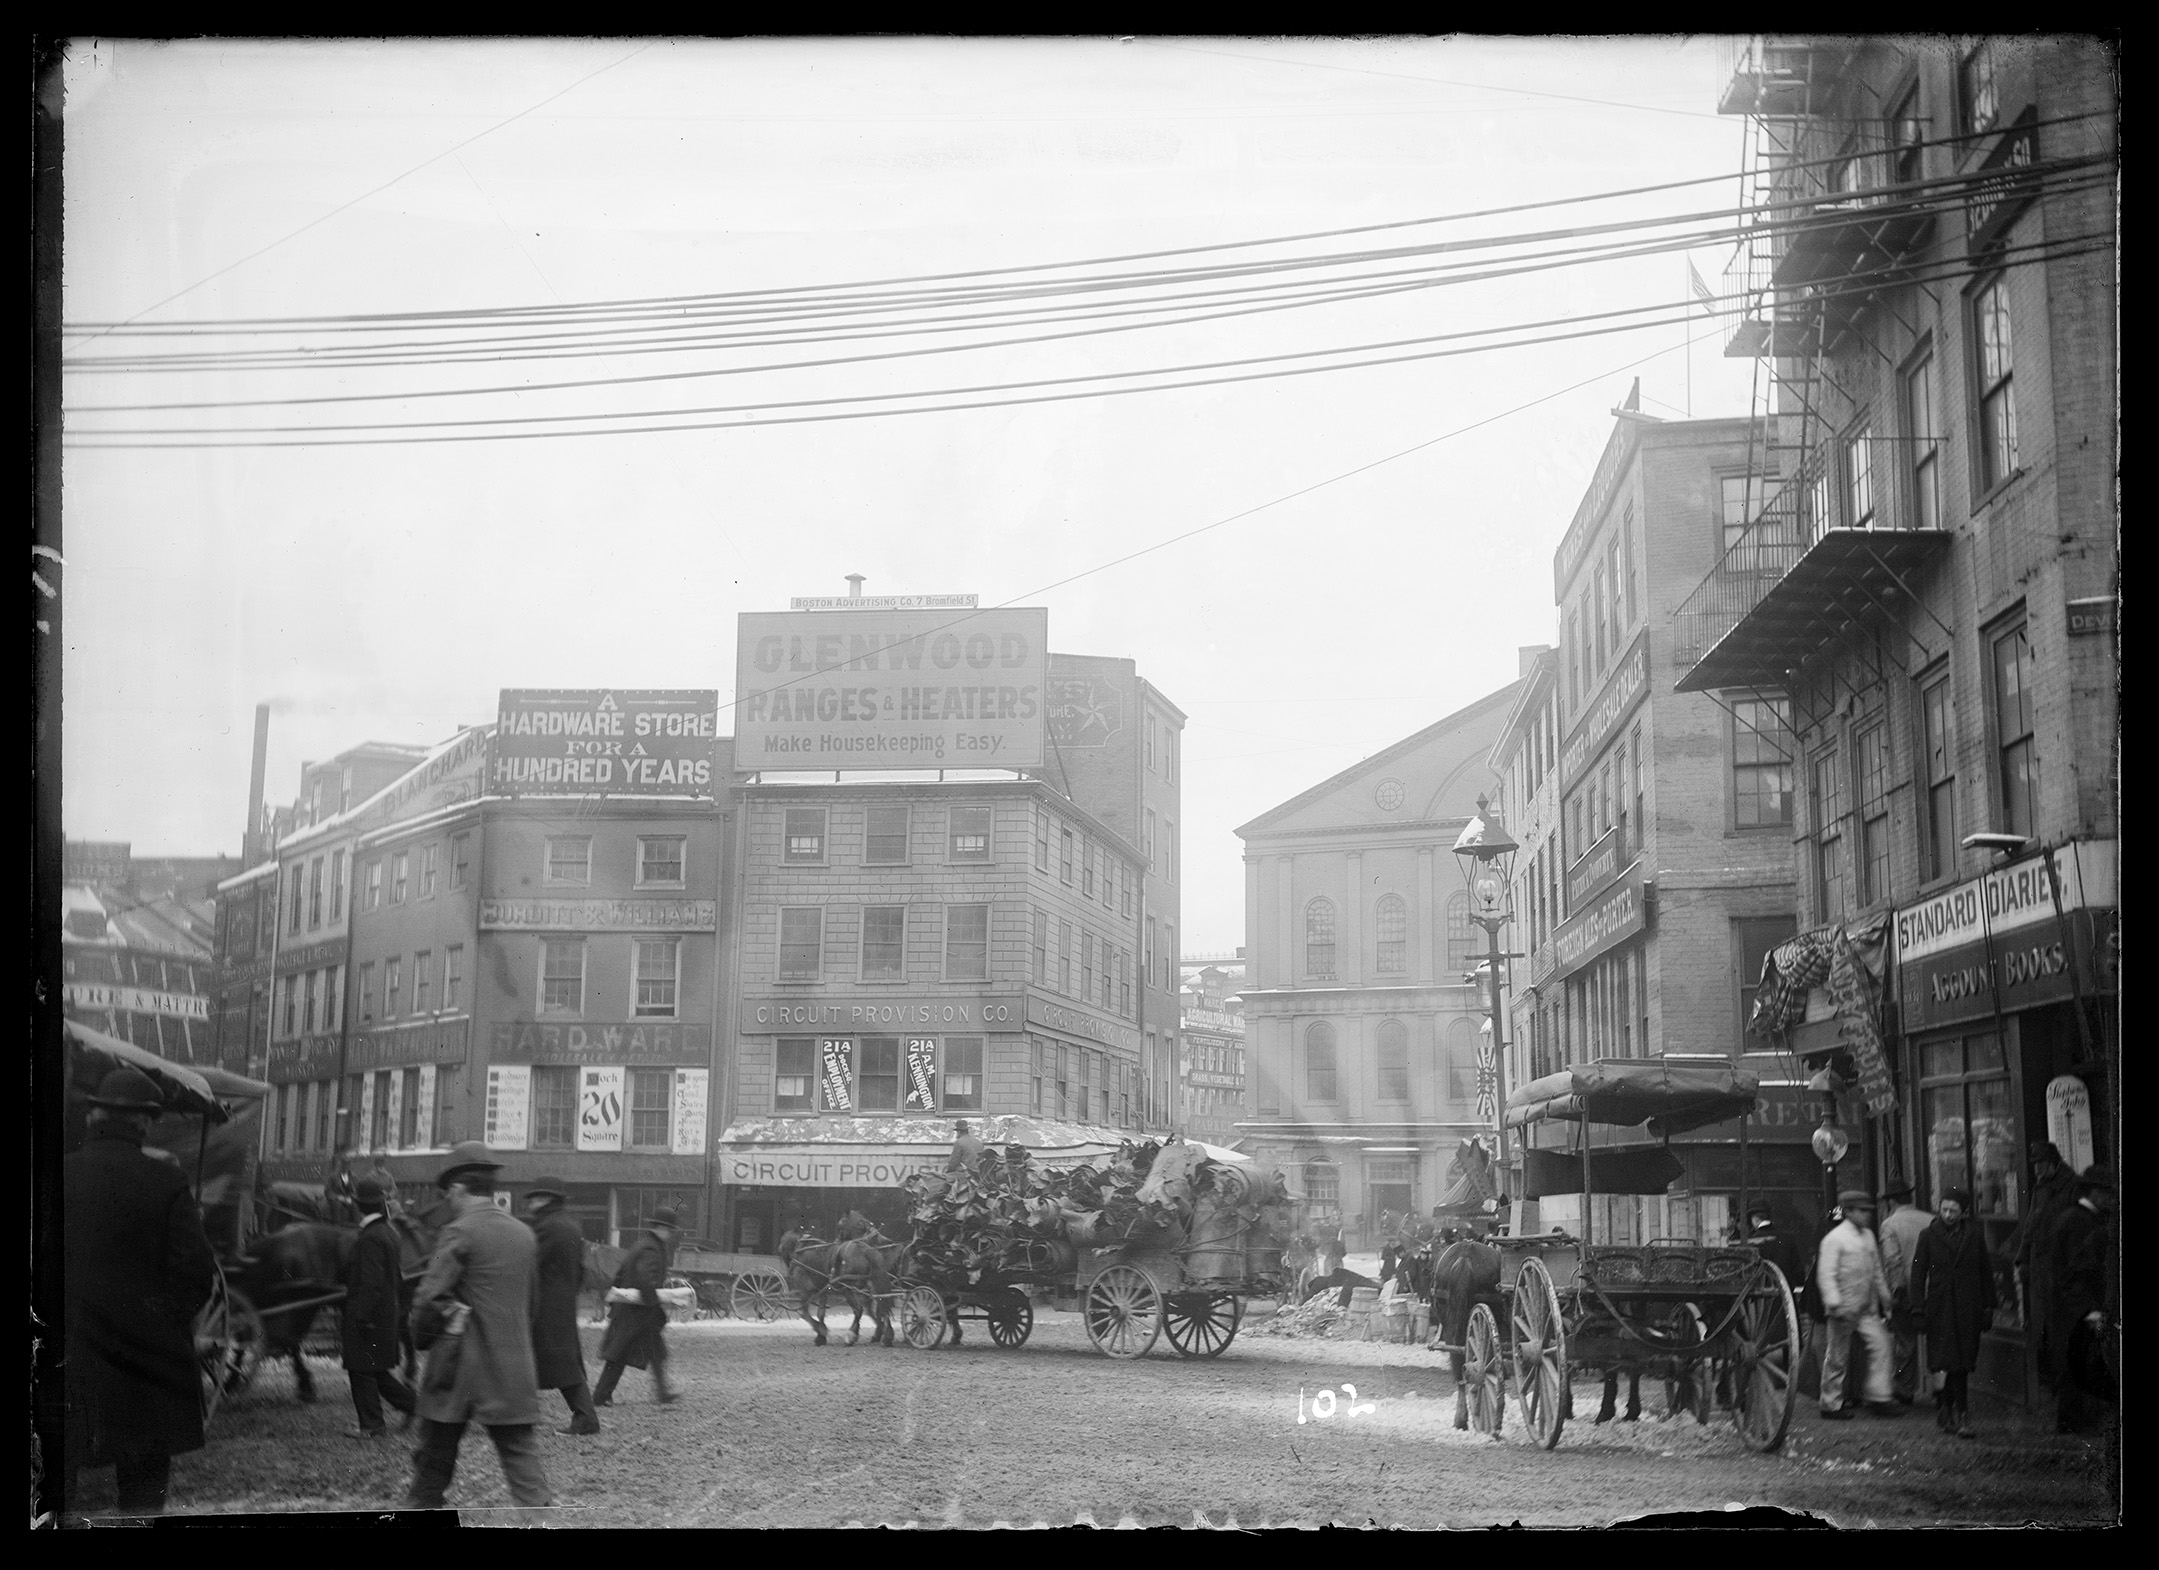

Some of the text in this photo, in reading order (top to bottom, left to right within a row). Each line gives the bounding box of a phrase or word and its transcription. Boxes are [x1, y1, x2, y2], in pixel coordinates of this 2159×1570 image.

[795, 598, 832, 607] BOSTON
[836, 597, 896, 607] ADVERTISING
[916, 597, 922, 605] 7
[925, 595, 964, 605] Bromfield
[755, 632, 1029, 673] GLENWOOD
[597, 692, 618, 711] A
[747, 687, 878, 723] RANGES
[883, 694, 895, 712] &
[900, 685, 1038, 722] HEATERS
[501, 711, 714, 737] HARDWARE STORE
[566, 740, 648, 756] FOR A
[764, 732, 1007, 759] Make Housekeeping Easy.
[497, 757, 711, 784] HUNDRED YEARS
[1900, 887, 1978, 949] STANDARD
[756, 1003, 1015, 1024] CIRCUIT PROVISION CO.
[823, 1040, 851, 1053] 21A
[910, 1039, 935, 1052] 21A
[822, 1078, 837, 1110] OFFICE
[823, 1052, 852, 1110] EMPLOYMENT
[907, 1052, 935, 1111] KENNINGTON
[582, 1090, 620, 1127] 20
[583, 1130, 618, 1144] Square
[733, 1162, 833, 1182] CIRCUIT
